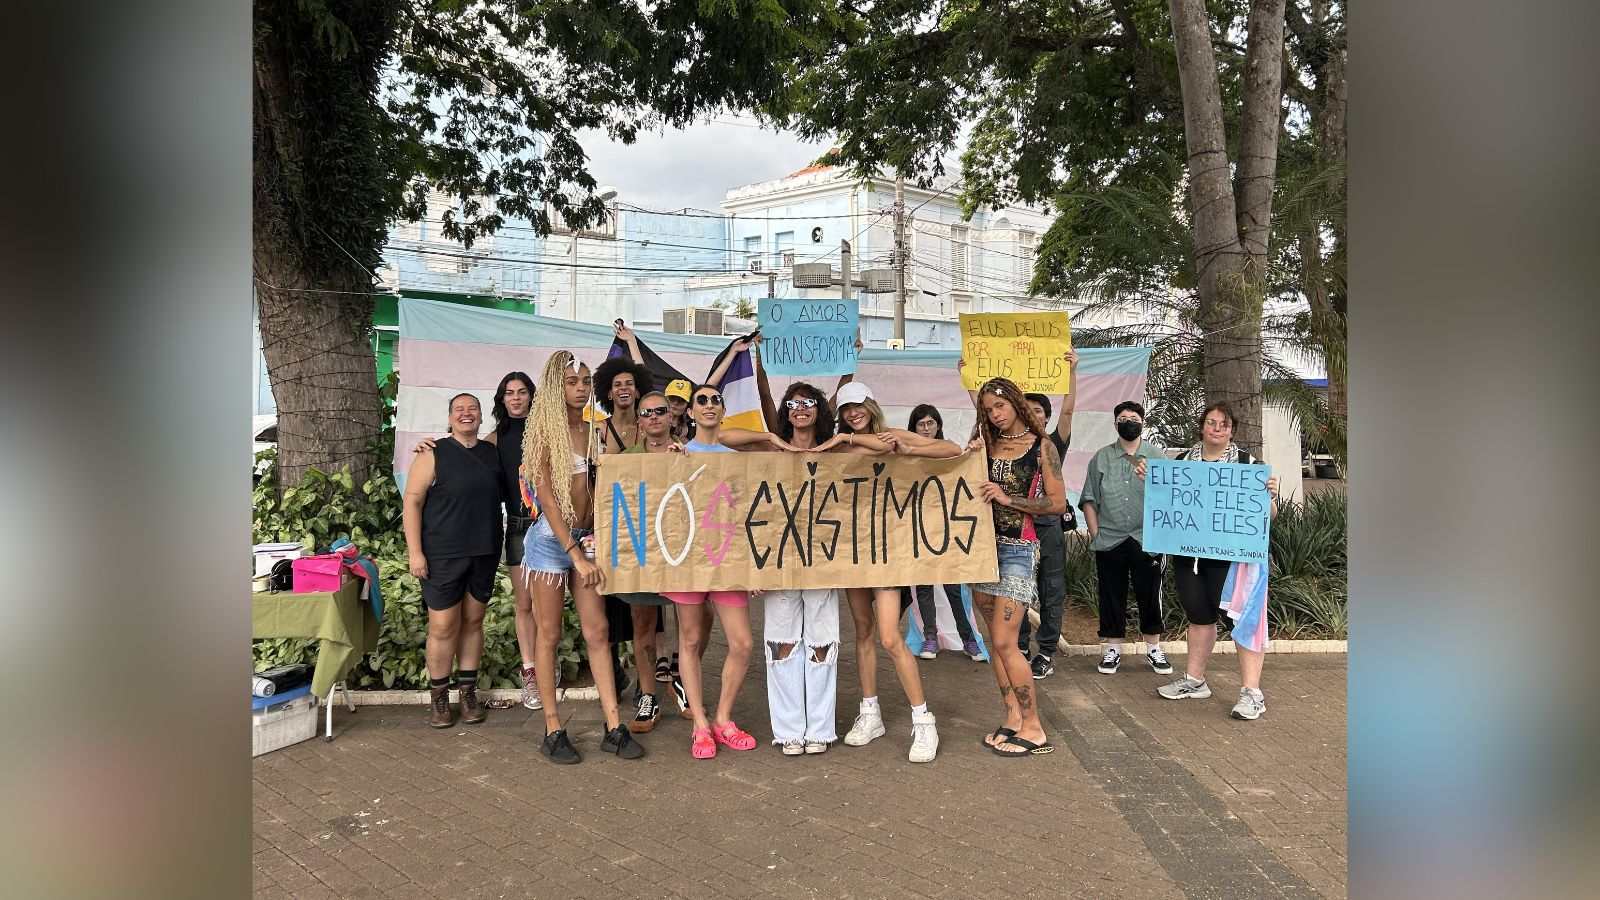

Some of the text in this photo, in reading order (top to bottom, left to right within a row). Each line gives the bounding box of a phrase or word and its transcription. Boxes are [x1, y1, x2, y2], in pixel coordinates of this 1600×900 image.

[771, 303, 848, 323] O AMOR
[968, 319, 1061, 337] ELUS DELUS
[762, 335, 856, 365] TRANSFORMA
[967, 341, 1036, 358] POR PARA
[977, 357, 1062, 379] ELUS ELUS
[1171, 488, 1204, 509] POR
[611, 464, 738, 568] NÓS
[1152, 509, 1199, 532] PARA
[1179, 545, 1207, 554] MARCHA
[1208, 546, 1235, 557] TRANS
